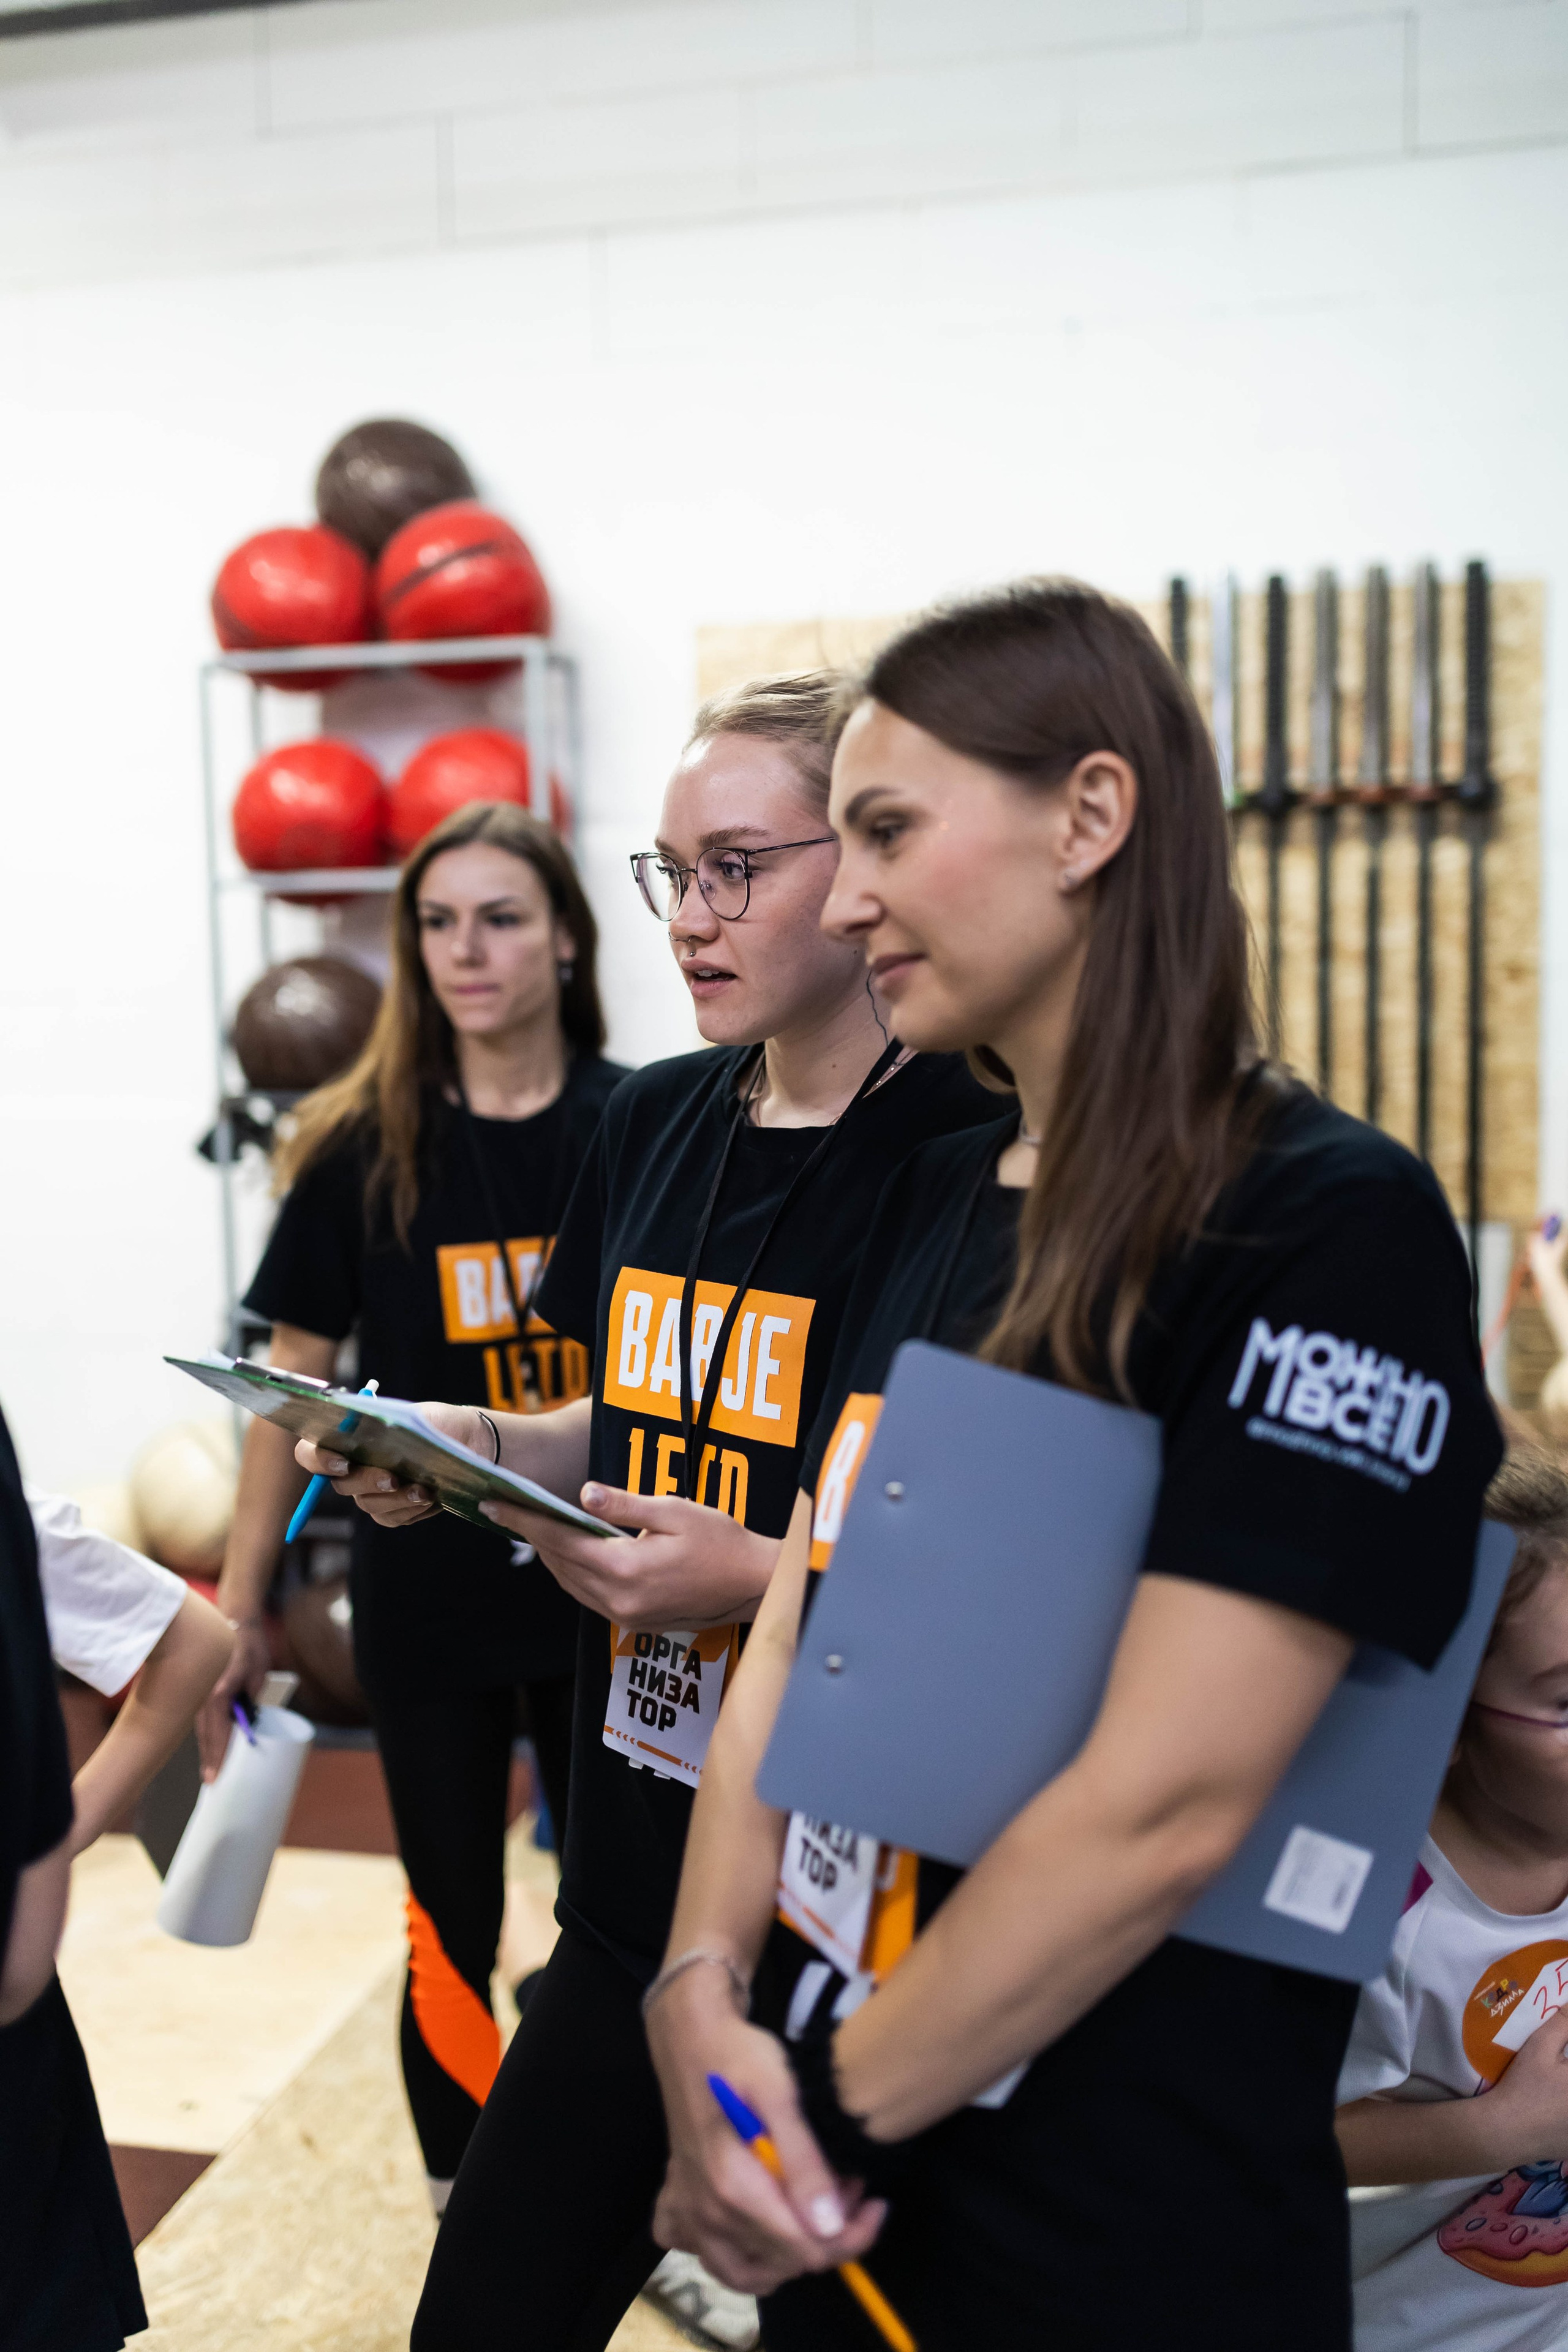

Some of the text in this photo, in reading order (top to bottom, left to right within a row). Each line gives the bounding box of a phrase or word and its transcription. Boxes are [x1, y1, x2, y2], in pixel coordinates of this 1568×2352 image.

[618, 1290, 792, 1420] BABJE
[634, 1632, 702, 1681] ОРГА
[627, 1688, 677, 1732] ТОР
[628, 1657, 700, 1714] НИЗА
[799, 1836, 837, 1893] ТОР
